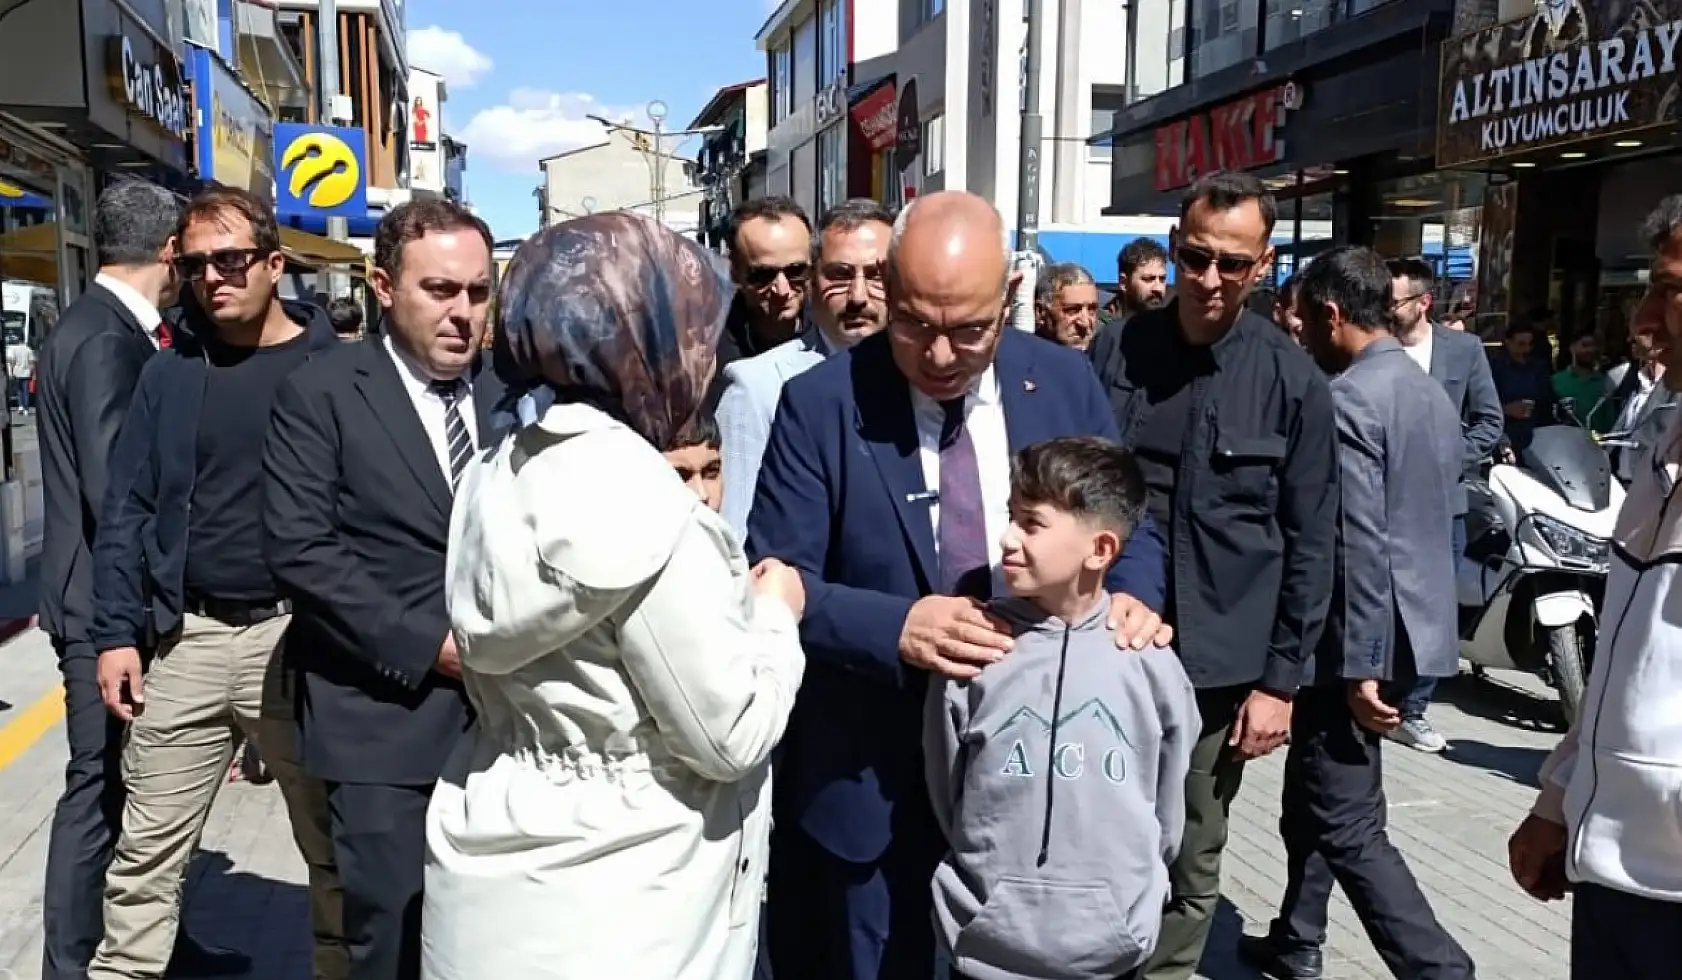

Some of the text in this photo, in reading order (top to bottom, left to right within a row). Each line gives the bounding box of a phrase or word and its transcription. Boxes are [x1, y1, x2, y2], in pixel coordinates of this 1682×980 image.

[121, 36, 154, 118] Can
[1449, 20, 1682, 124] ALTINSARAY
[1481, 90, 1630, 151] KUYUMCULUK
